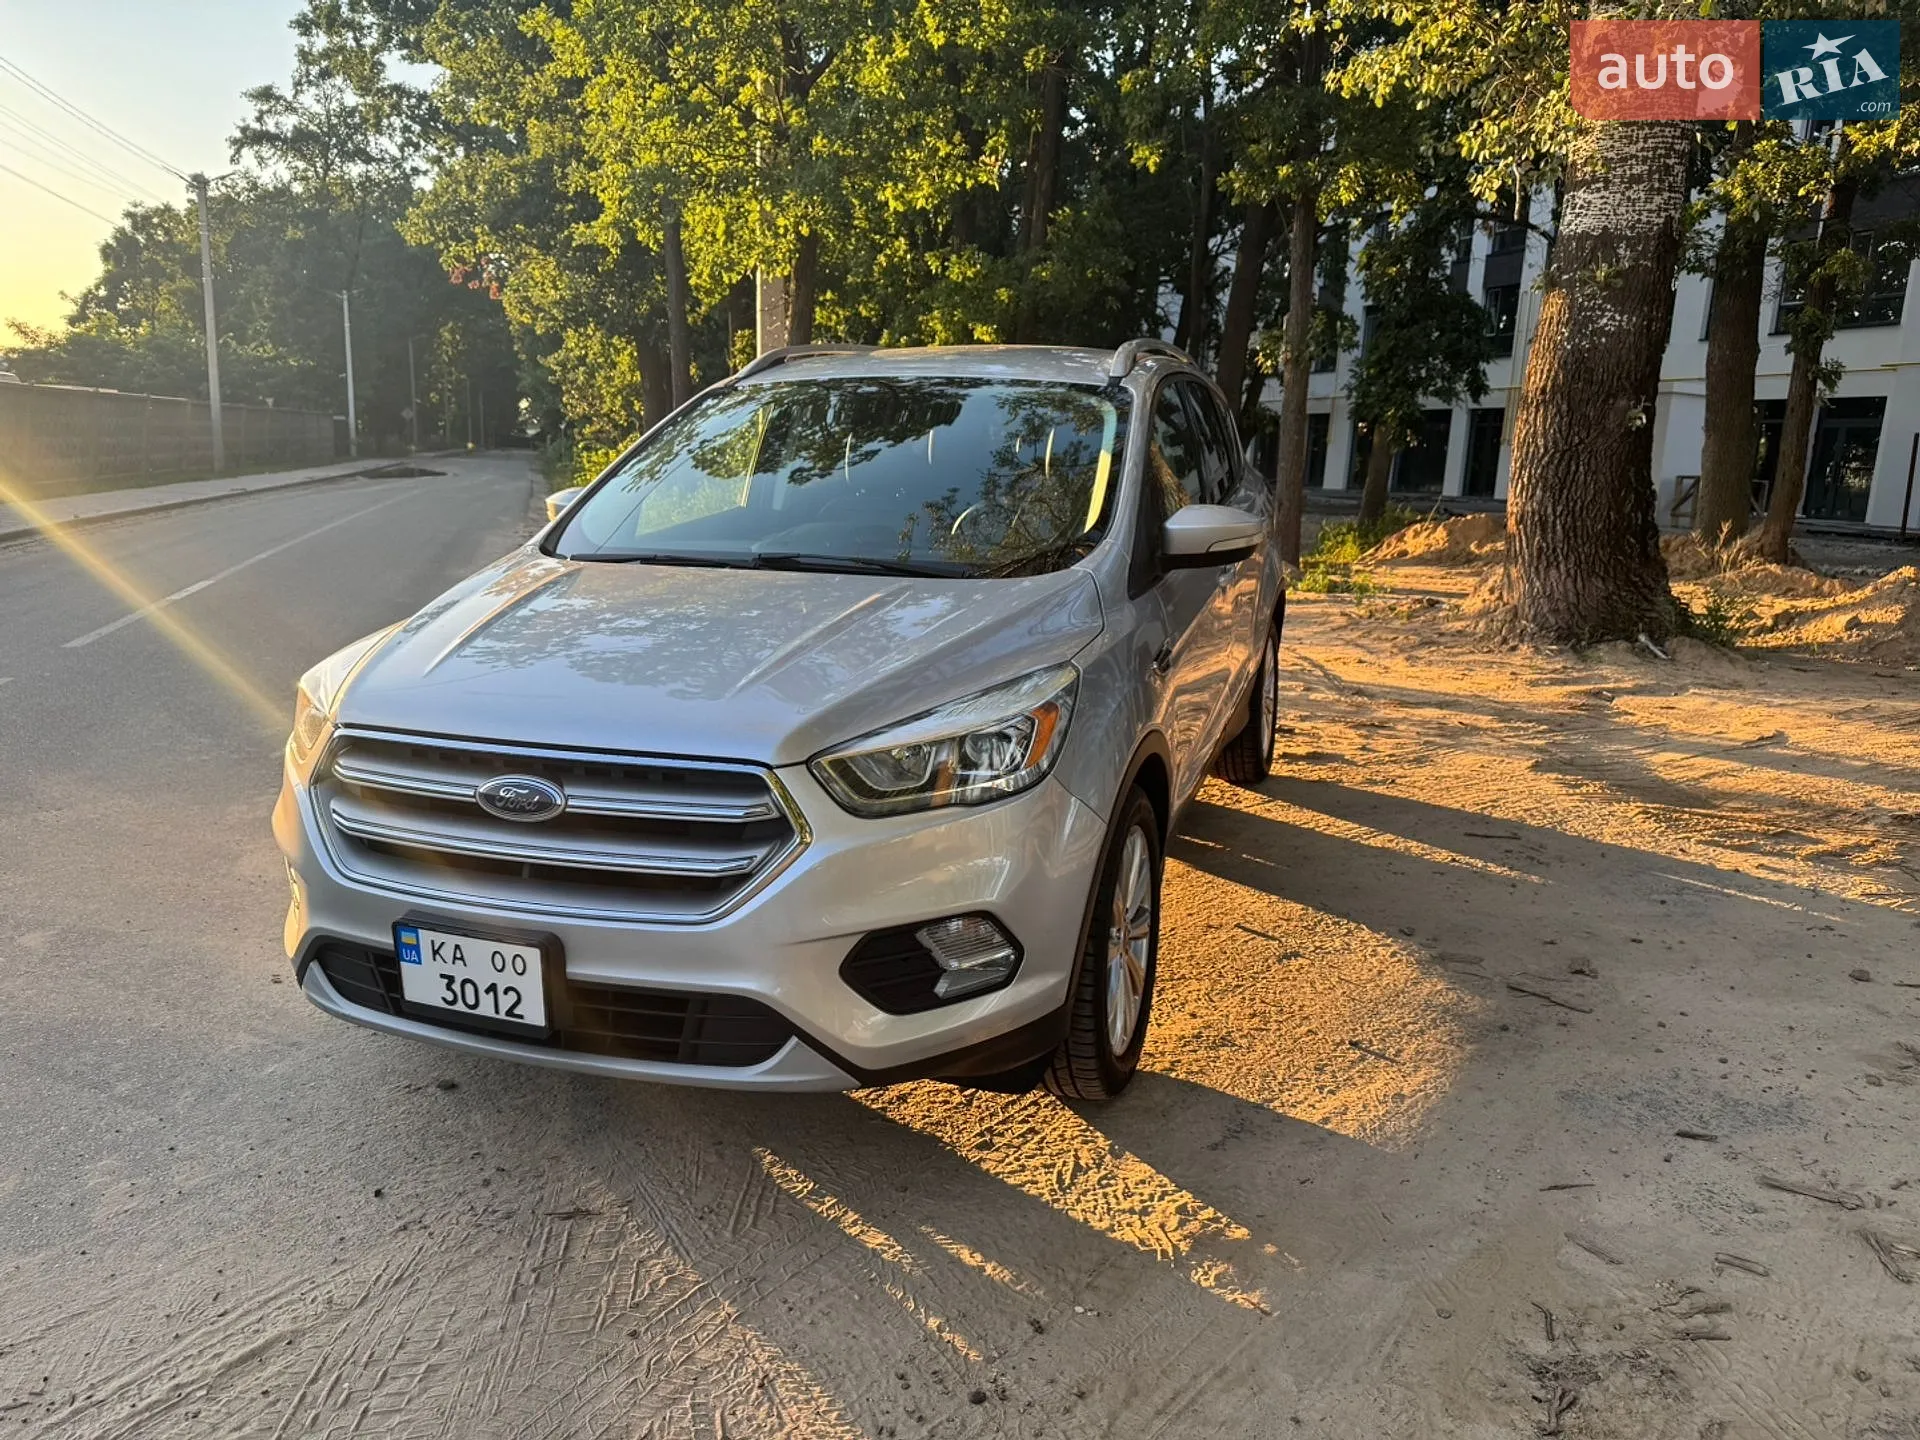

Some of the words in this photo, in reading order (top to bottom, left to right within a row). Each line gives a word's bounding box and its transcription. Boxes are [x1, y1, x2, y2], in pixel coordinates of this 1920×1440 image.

[495, 786, 540, 810] Ford
[402, 949, 419, 962] UA
[430, 939, 467, 967] KA
[491, 950, 527, 976] 00
[439, 973, 524, 1020] 3012
